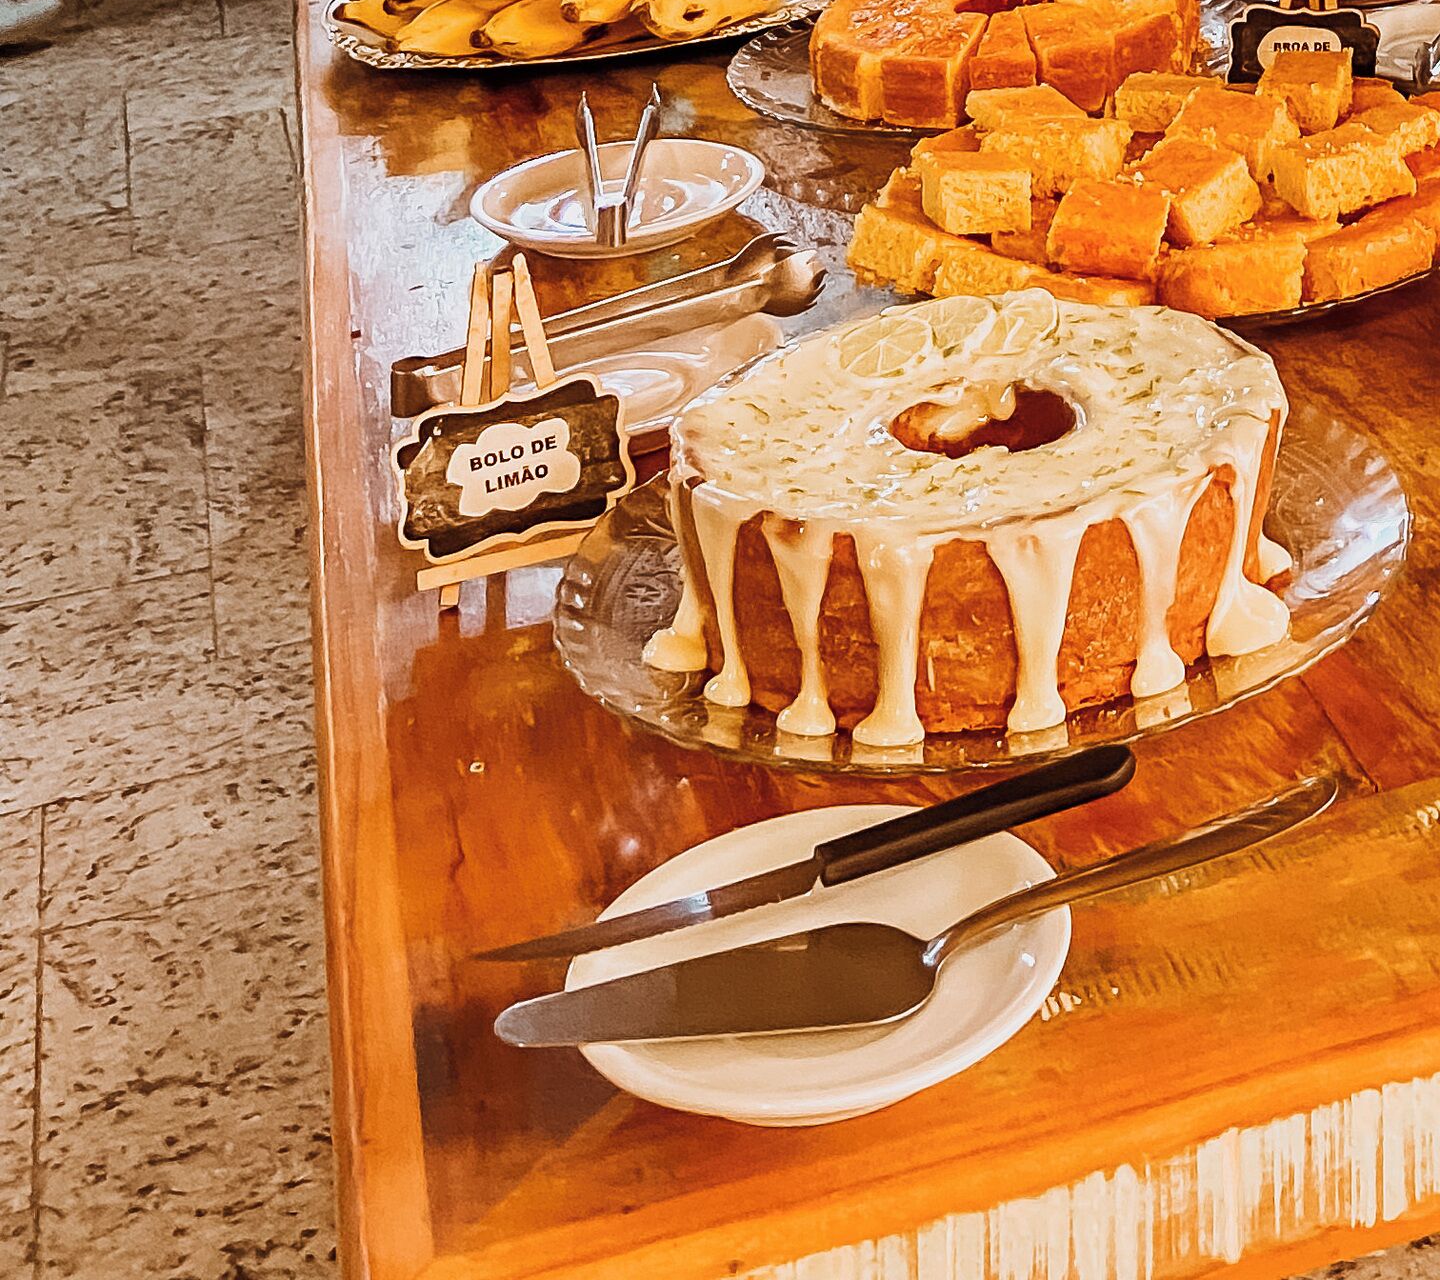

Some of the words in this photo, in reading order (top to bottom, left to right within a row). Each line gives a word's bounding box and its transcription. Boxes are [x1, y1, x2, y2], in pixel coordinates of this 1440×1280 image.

[1313, 41, 1331, 52] DE
[469, 445, 524, 472] BOLO
[530, 435, 558, 455] DE
[484, 464, 549, 494] LIMÃO
